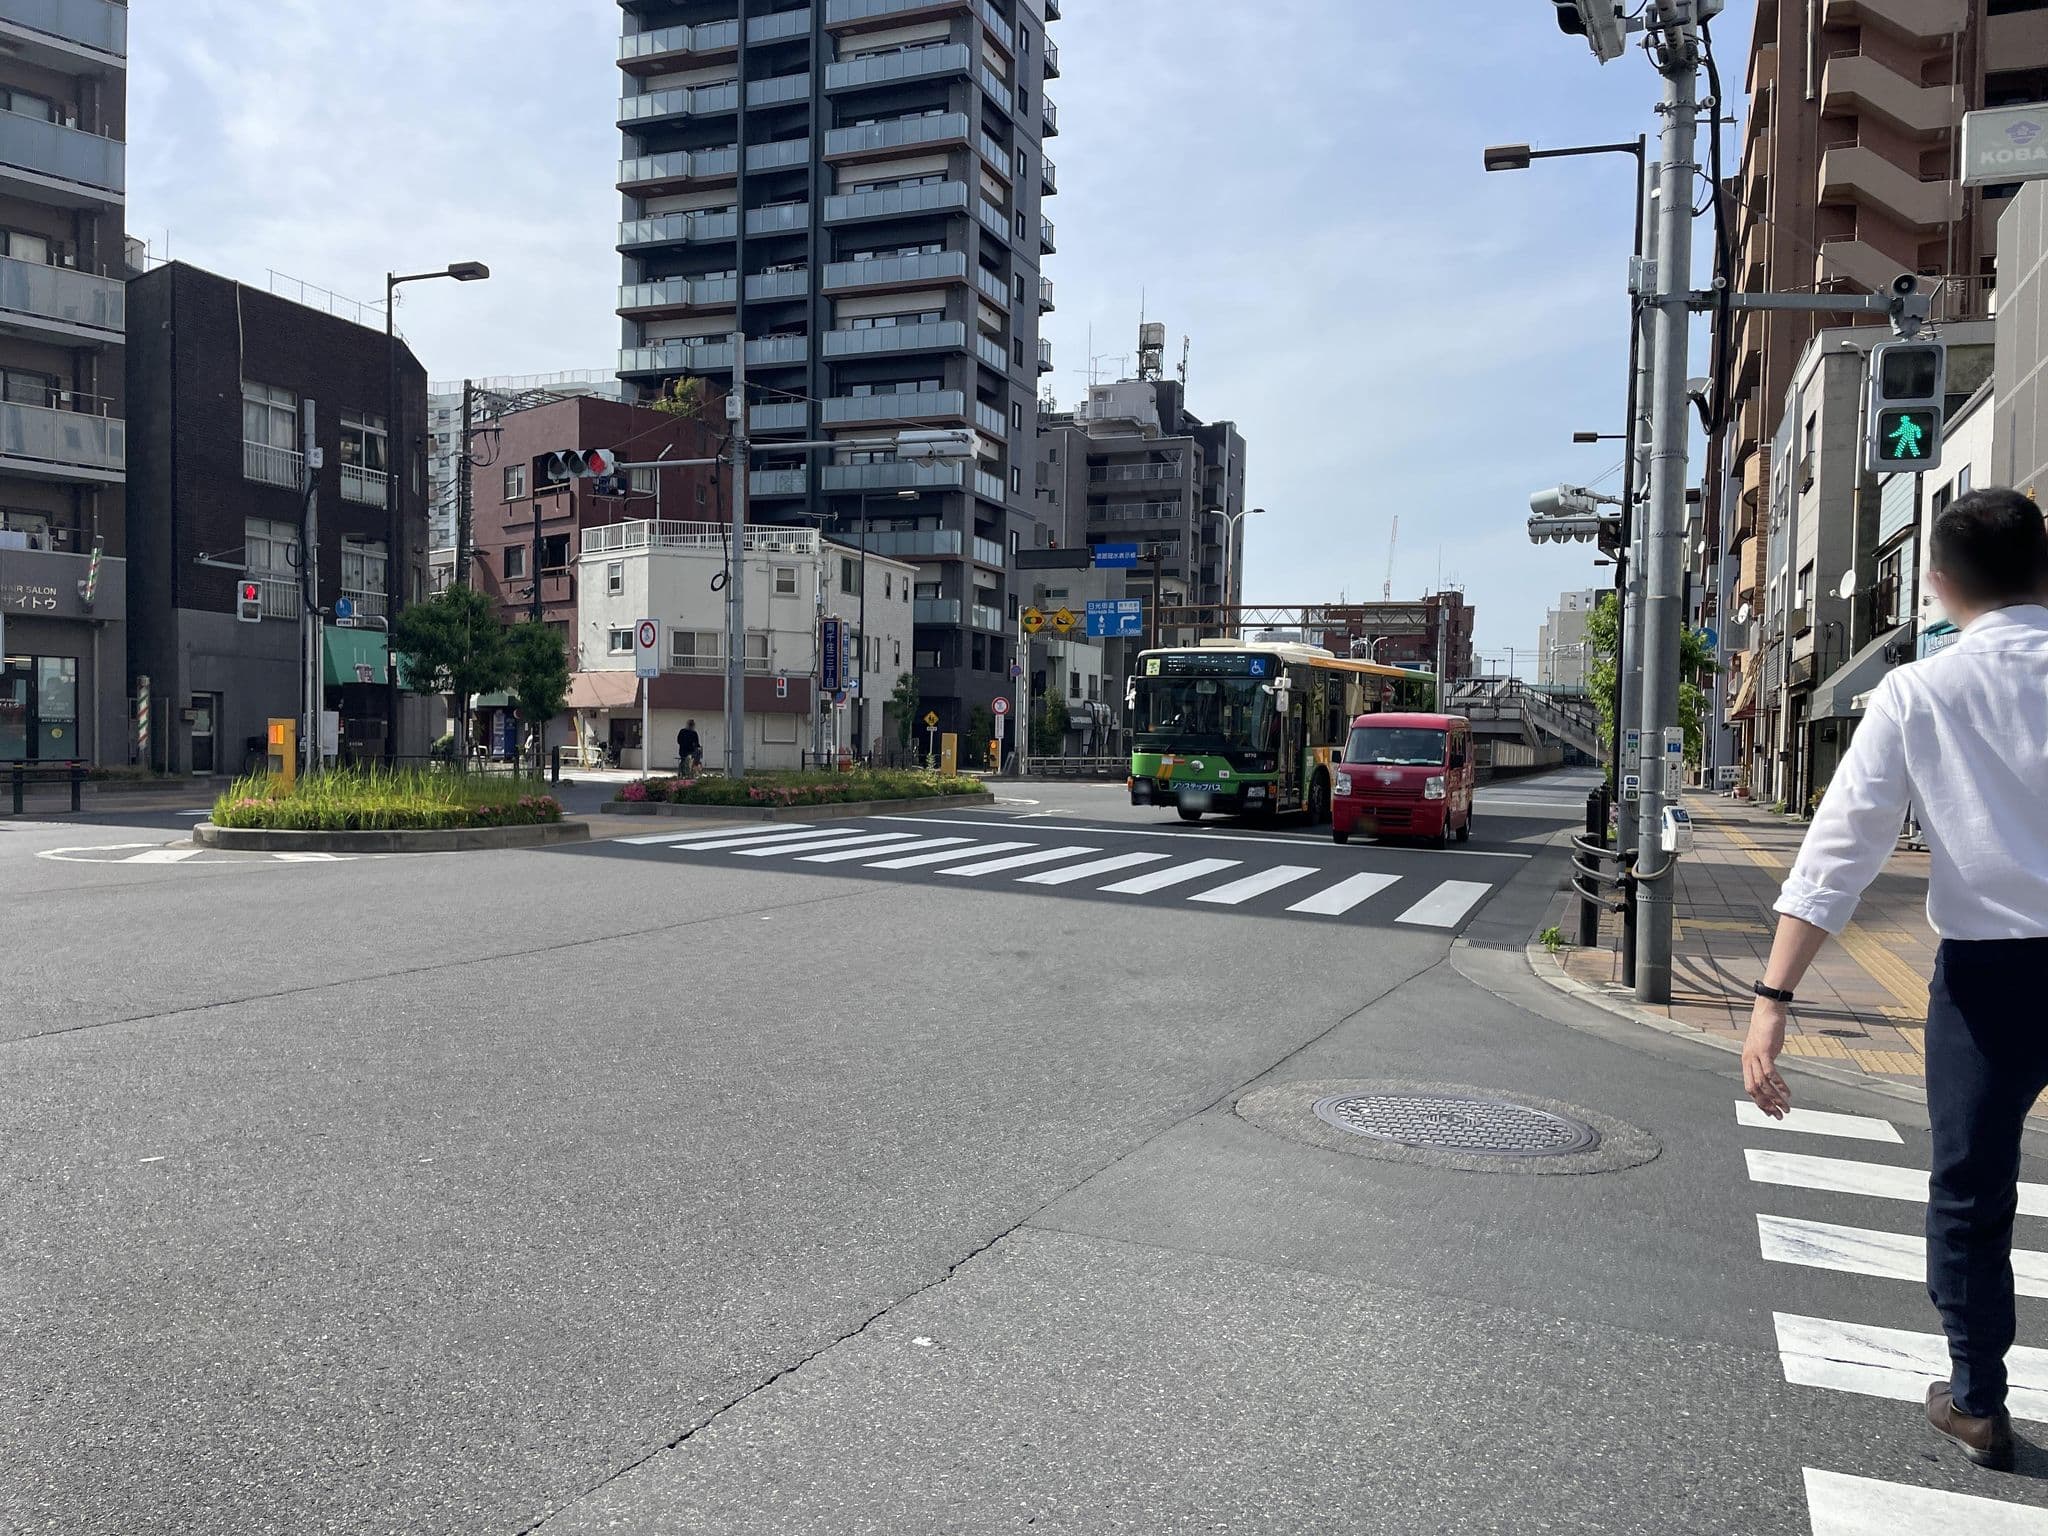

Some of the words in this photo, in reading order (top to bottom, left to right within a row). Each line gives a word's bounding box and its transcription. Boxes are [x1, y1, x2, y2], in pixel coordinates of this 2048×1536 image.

[26, 585, 57, 596] SALON
[1, 595, 57, 610] サイトウ
